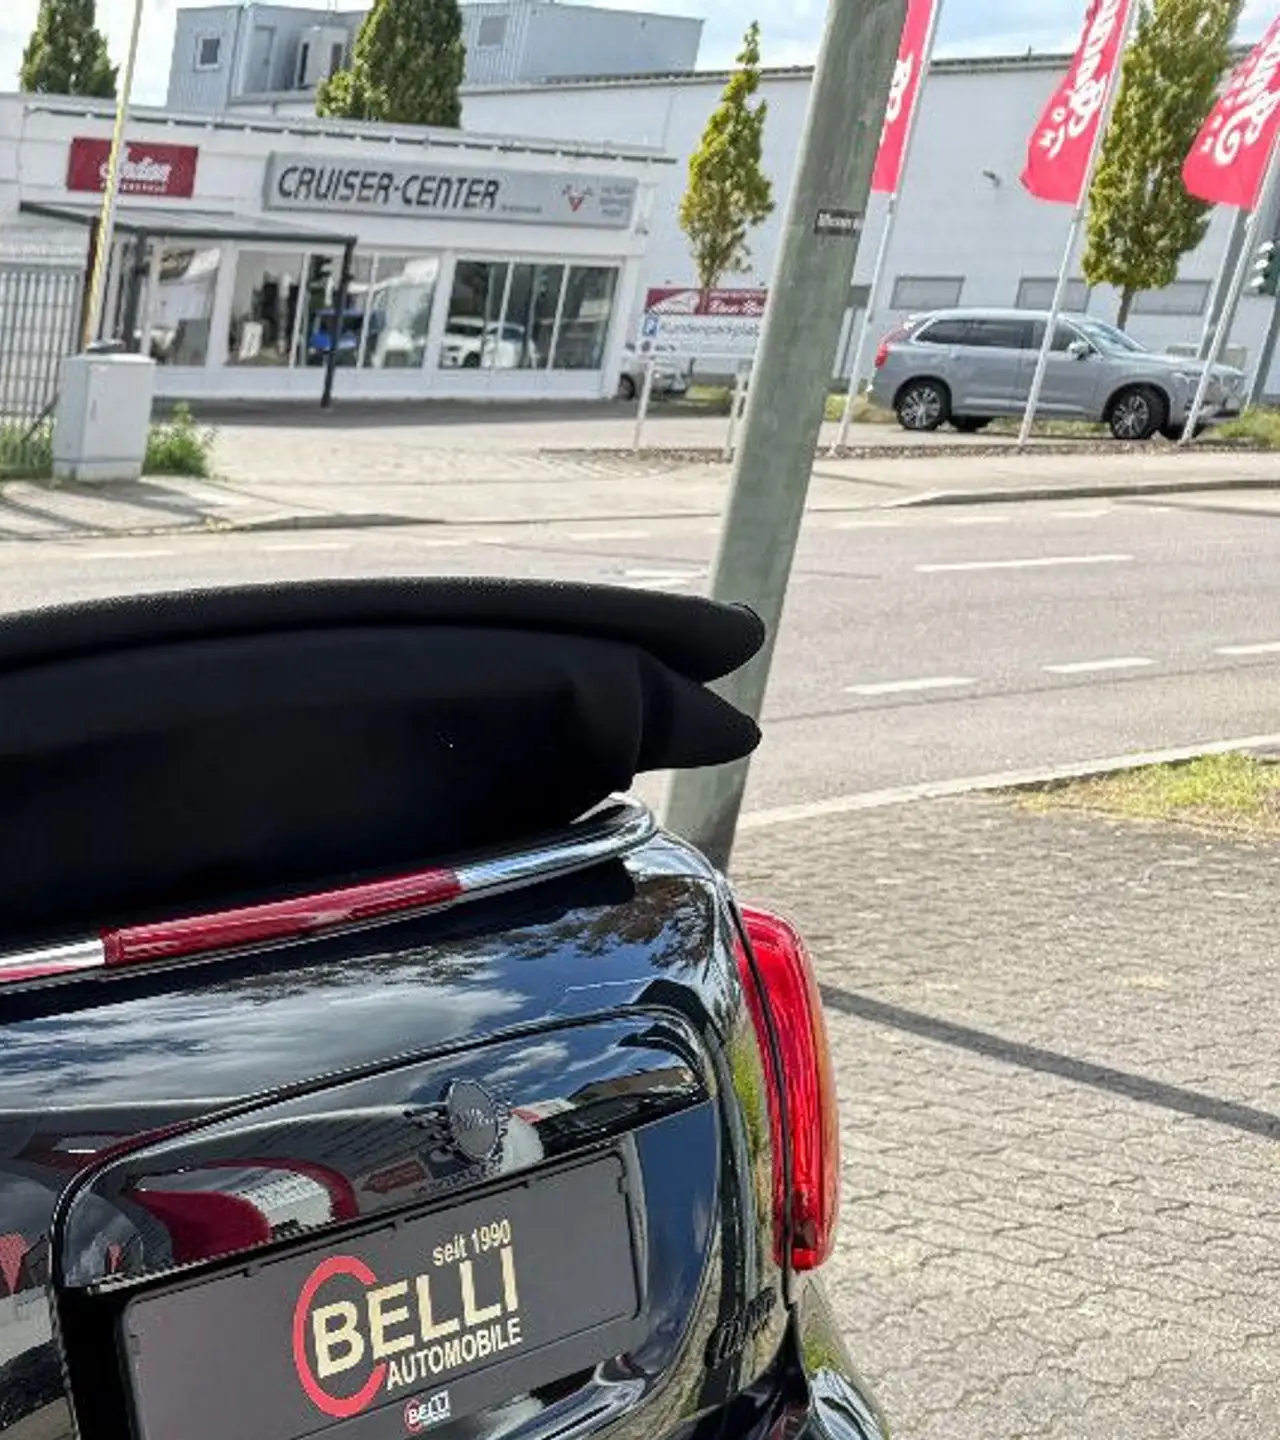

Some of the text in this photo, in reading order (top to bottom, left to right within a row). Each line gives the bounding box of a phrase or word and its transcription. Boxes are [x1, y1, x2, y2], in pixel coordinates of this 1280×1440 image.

[278, 165, 500, 210] CRUISER-CENTER
[432, 1218, 512, 1267] seit 1990
[386, 1317, 523, 1391] AUTOMOBILE
